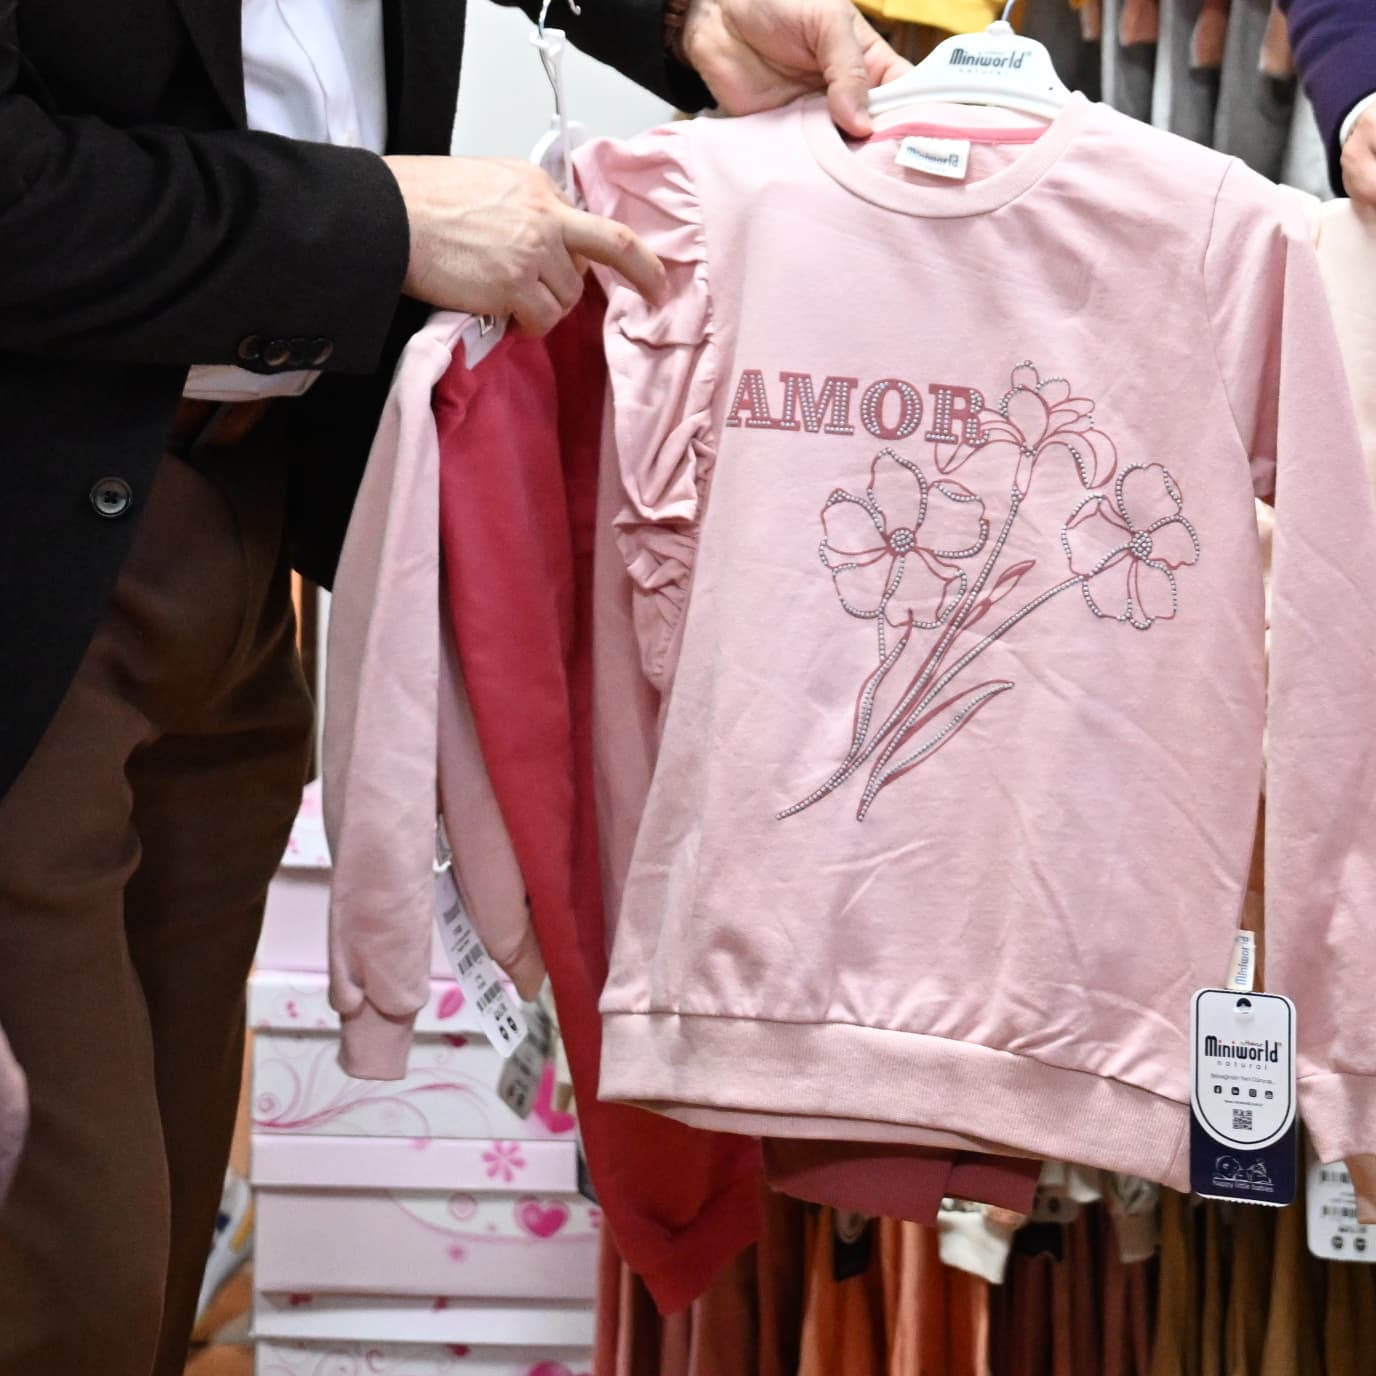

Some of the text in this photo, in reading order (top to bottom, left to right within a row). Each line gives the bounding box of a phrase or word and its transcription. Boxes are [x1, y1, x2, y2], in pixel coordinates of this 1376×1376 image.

[949, 47, 1026, 70] Miniworld
[725, 368, 990, 448] AMOR
[1204, 1034, 1279, 1063] Miniworld
